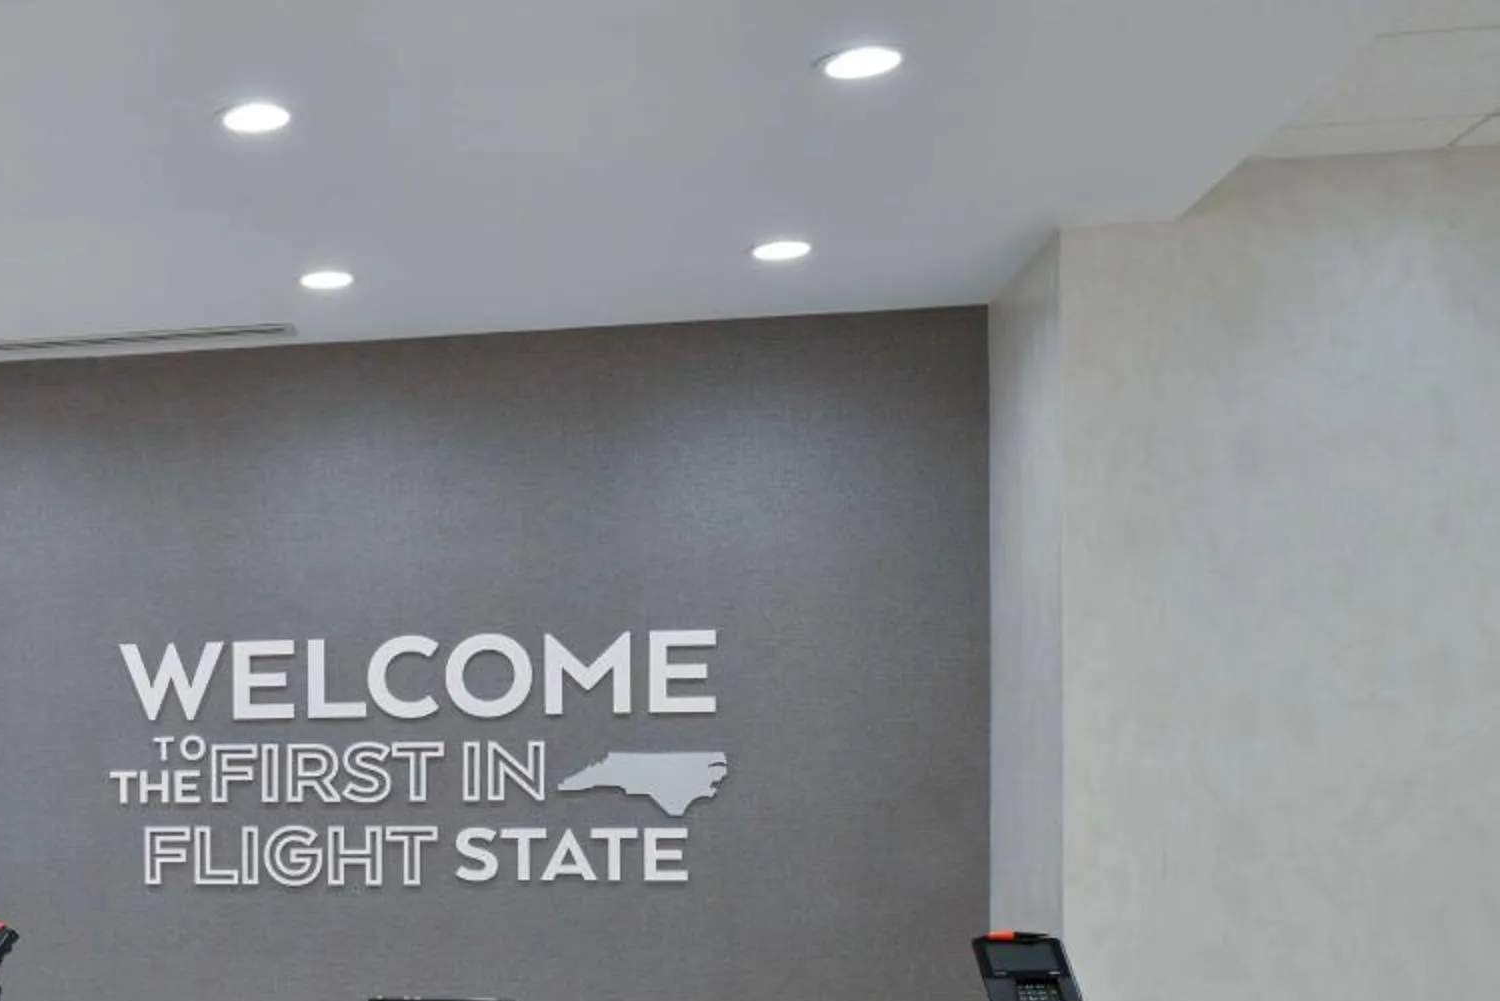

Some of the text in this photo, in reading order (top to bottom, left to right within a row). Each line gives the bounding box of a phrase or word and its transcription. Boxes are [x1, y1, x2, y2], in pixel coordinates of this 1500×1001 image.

[119, 630, 716, 721] WELCOME
[109, 740, 546, 804] THE FIRST IN
[153, 735, 206, 761] TO
[144, 825, 689, 887] FLIGHT STATE
